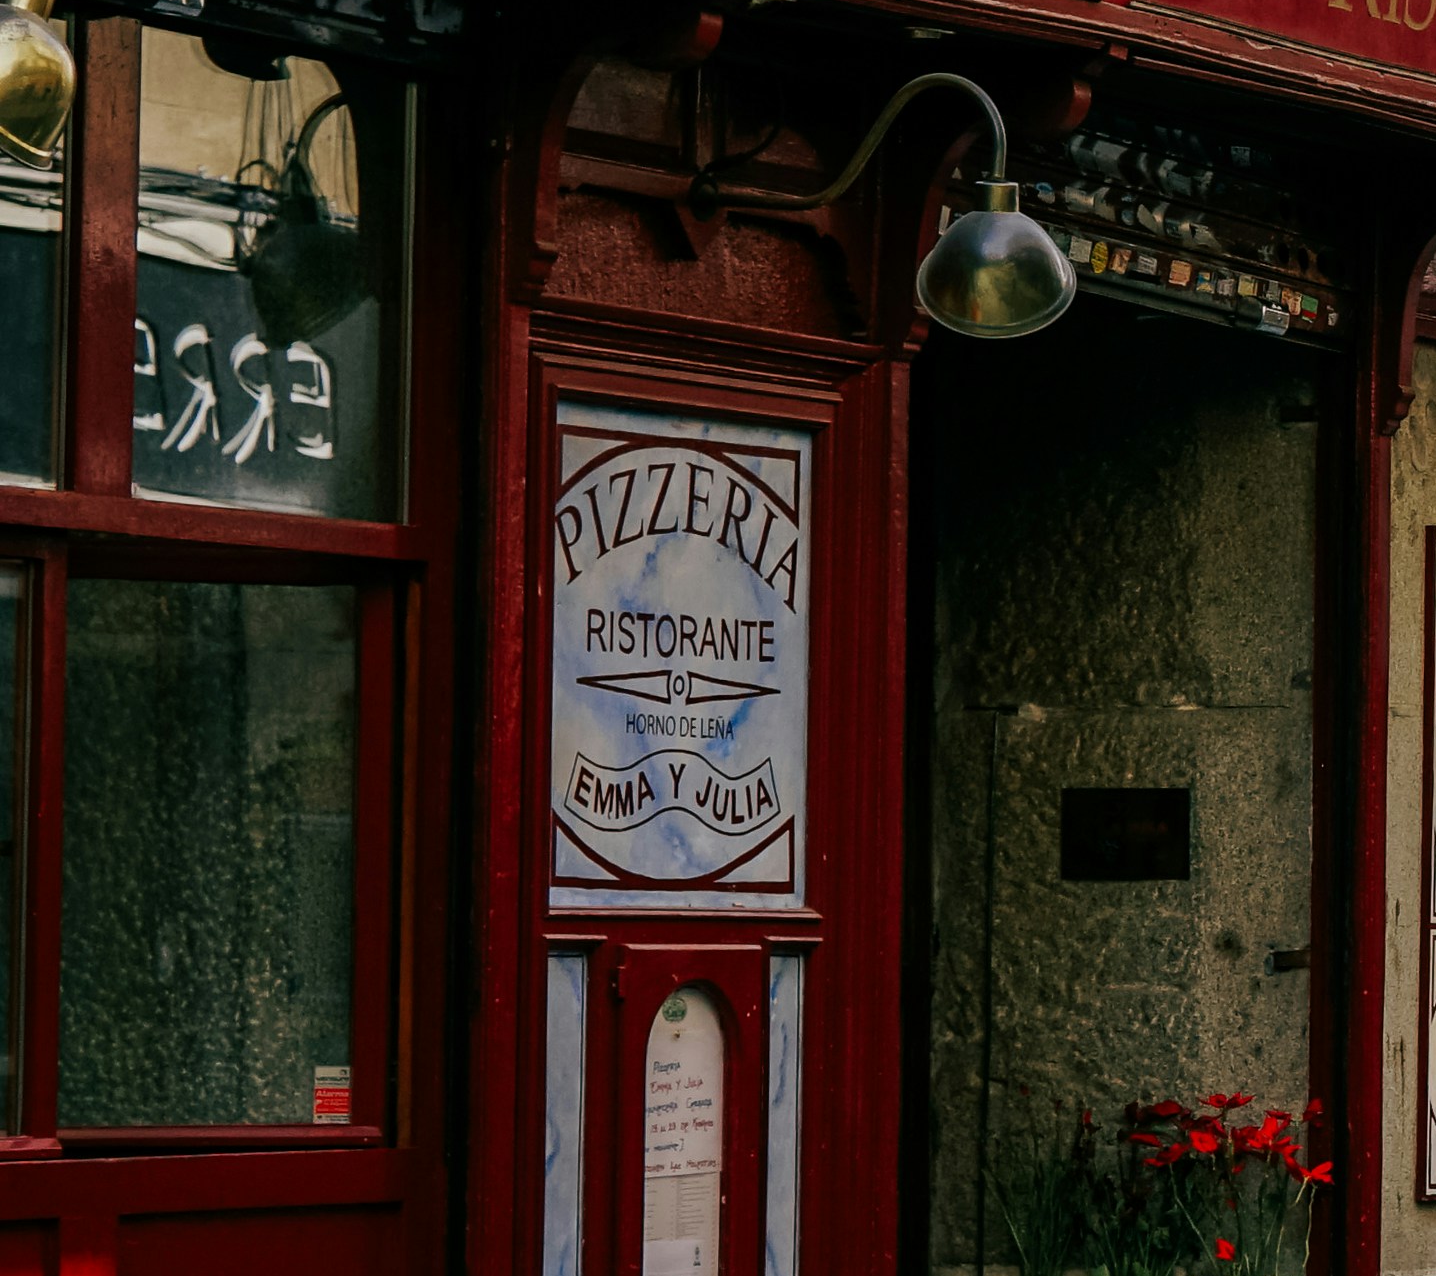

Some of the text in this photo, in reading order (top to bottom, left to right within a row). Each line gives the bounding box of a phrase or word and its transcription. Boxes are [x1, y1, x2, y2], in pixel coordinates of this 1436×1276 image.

[555, 462, 798, 613] PIZZERIA
[587, 609, 775, 662] RISTORANTE
[626, 713, 734, 740] HORNO DE LEÑA
[574, 763, 773, 823] EMMA Y JULIA
